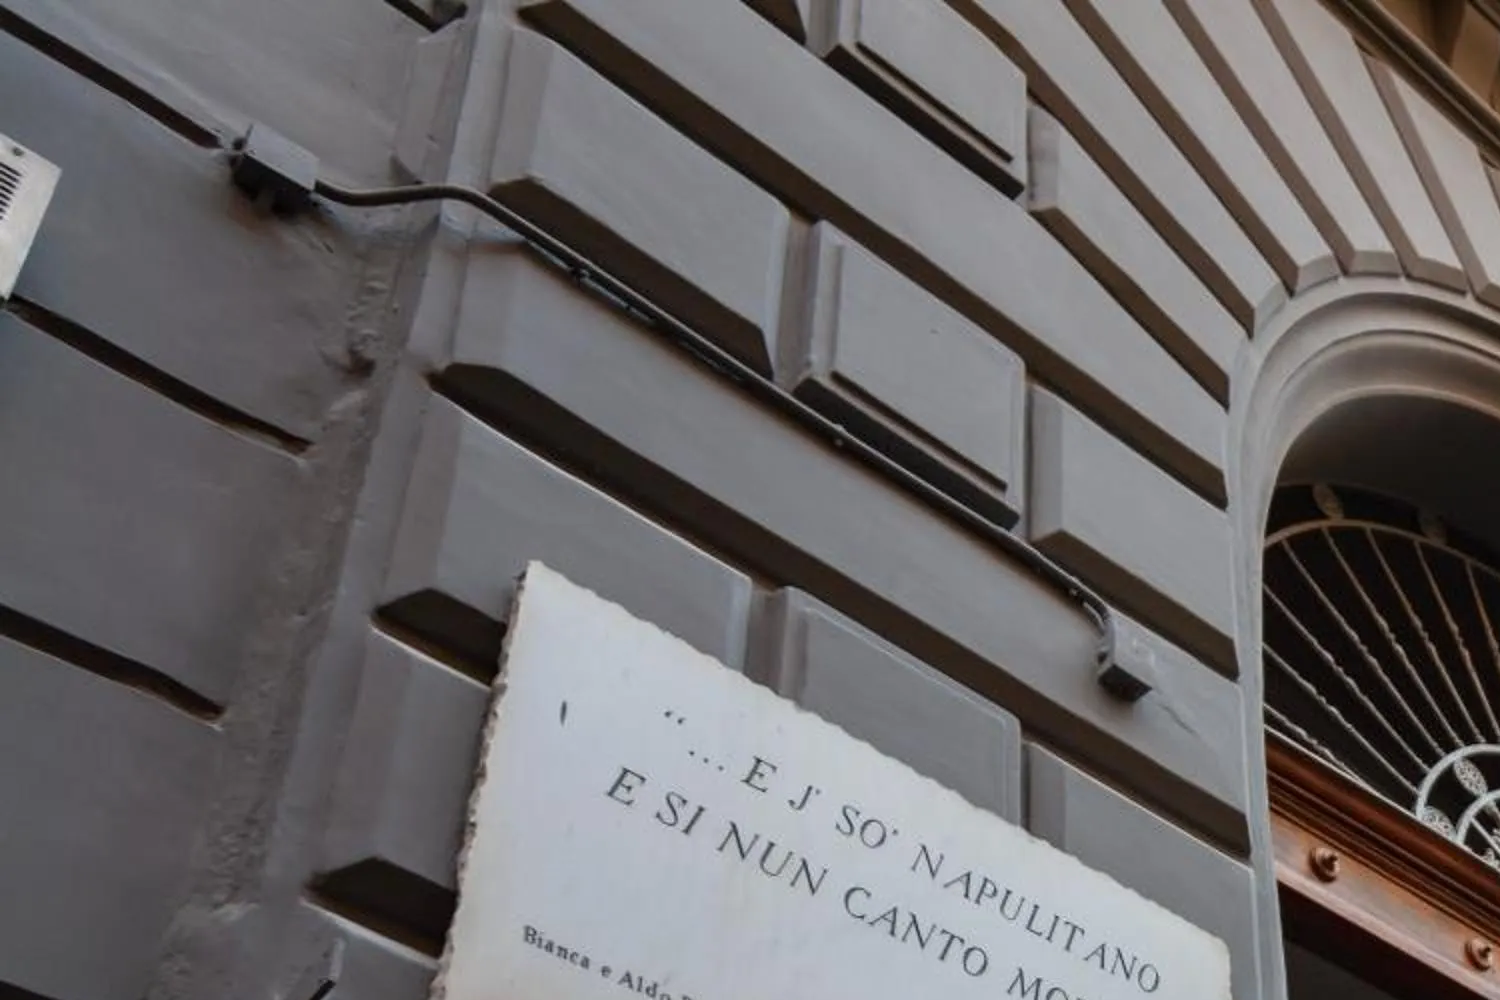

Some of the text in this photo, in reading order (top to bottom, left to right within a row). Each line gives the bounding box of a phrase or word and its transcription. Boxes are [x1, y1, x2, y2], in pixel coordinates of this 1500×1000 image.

[522, 924, 591, 971] Bianca
[600, 964, 613, 979] e
[604, 765, 647, 806] E
[654, 790, 705, 836] SI
[715, 820, 828, 896] NUN
[843, 885, 990, 978] CANTO
[740, 755, 778, 793] E
[910, 843, 1162, 994] NAPULITANO
